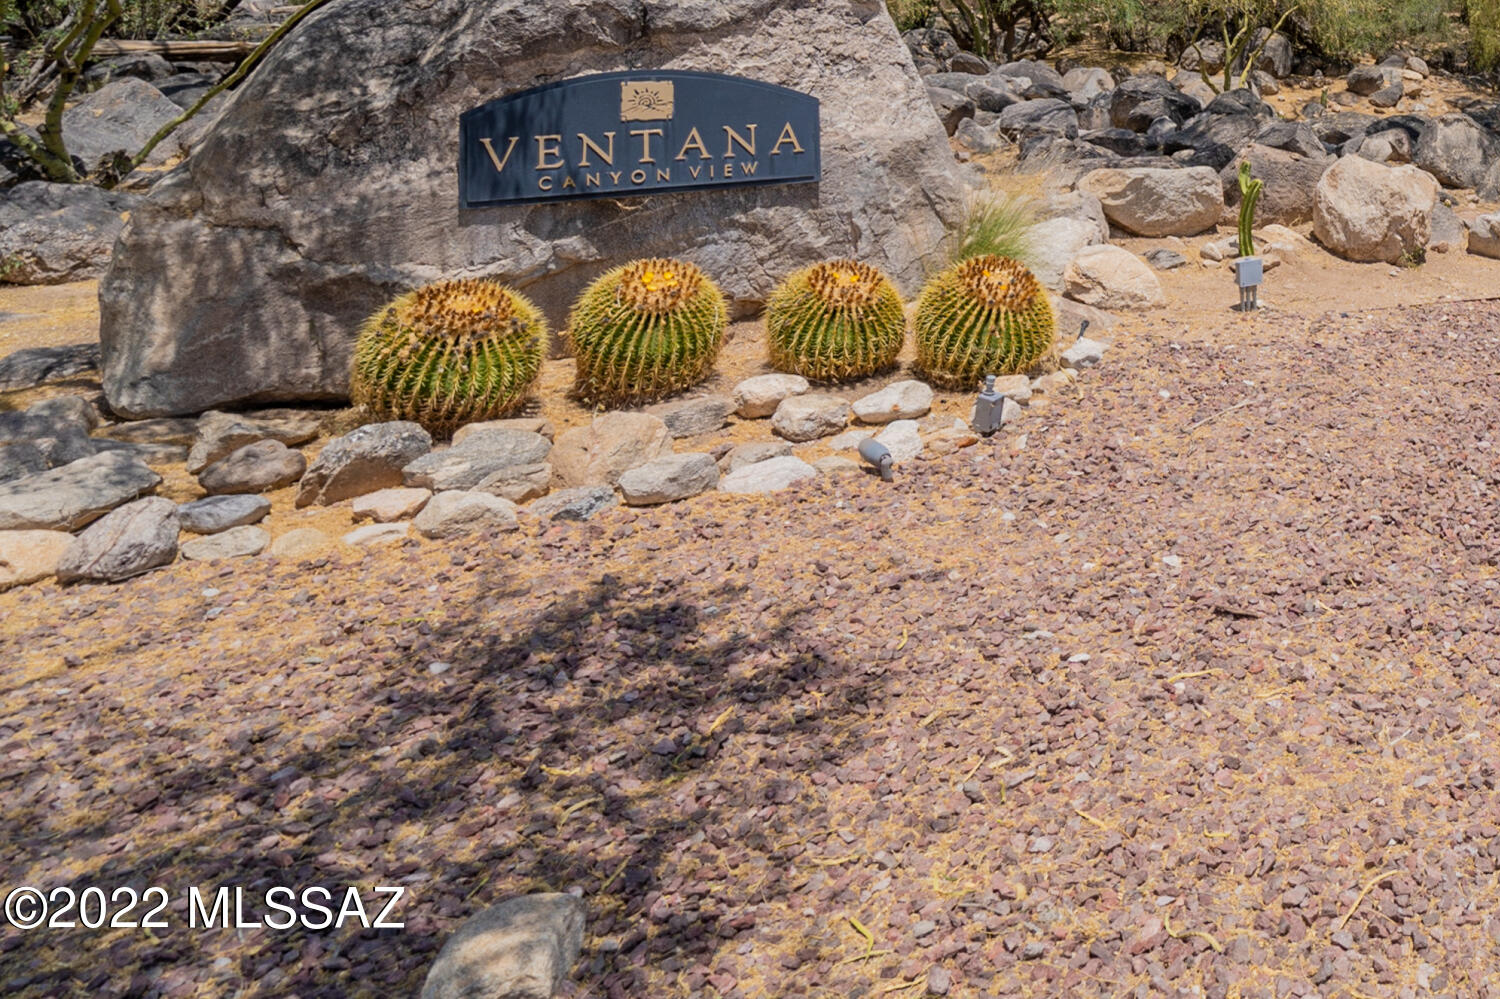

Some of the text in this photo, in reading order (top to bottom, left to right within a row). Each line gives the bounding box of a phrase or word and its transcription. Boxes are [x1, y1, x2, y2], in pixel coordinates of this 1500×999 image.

[480, 121, 805, 172] VENTANA
[538, 161, 759, 191] CANYON VIEW
